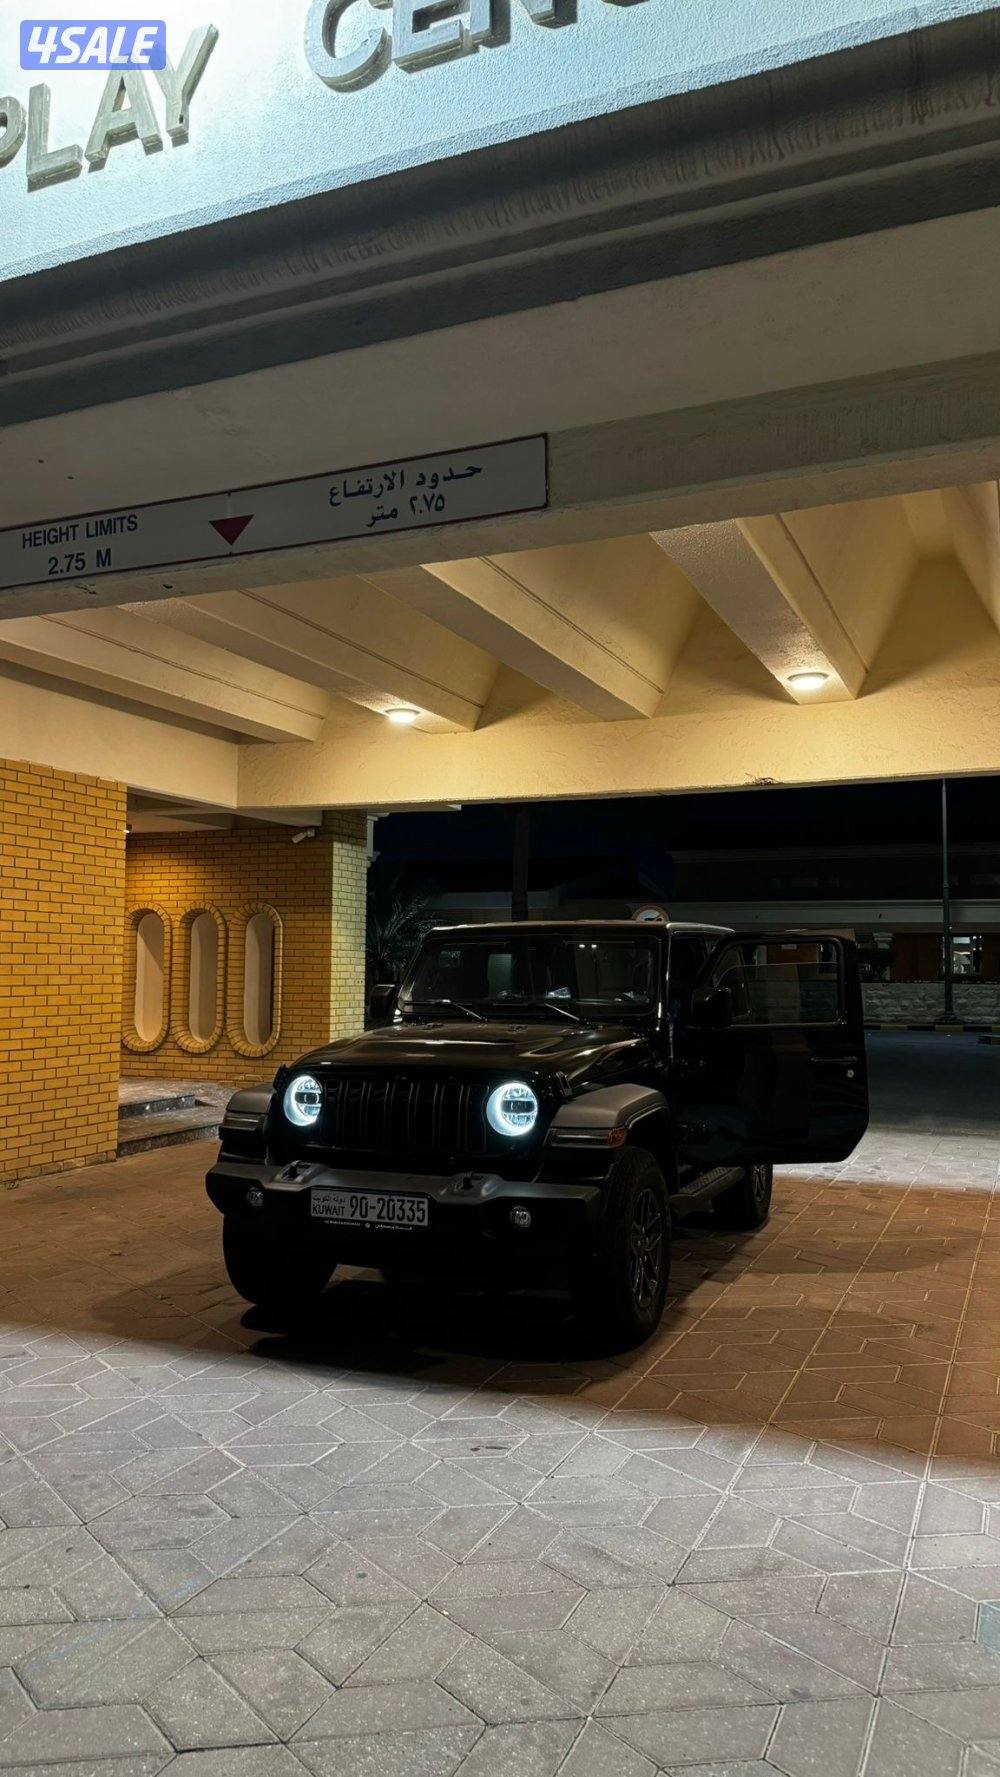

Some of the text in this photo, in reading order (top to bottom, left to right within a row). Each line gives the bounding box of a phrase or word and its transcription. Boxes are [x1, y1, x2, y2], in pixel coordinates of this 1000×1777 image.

[328, 465, 483, 507] حدود الارتفاع
[366, 505, 399, 527] متر
[22, 514, 138, 549] HEIGHT LIMITS
[48, 548, 112, 576] 2.75 M
[312, 1204, 345, 1216] KUWAIT
[349, 1195, 426, 1223] 90-20335
